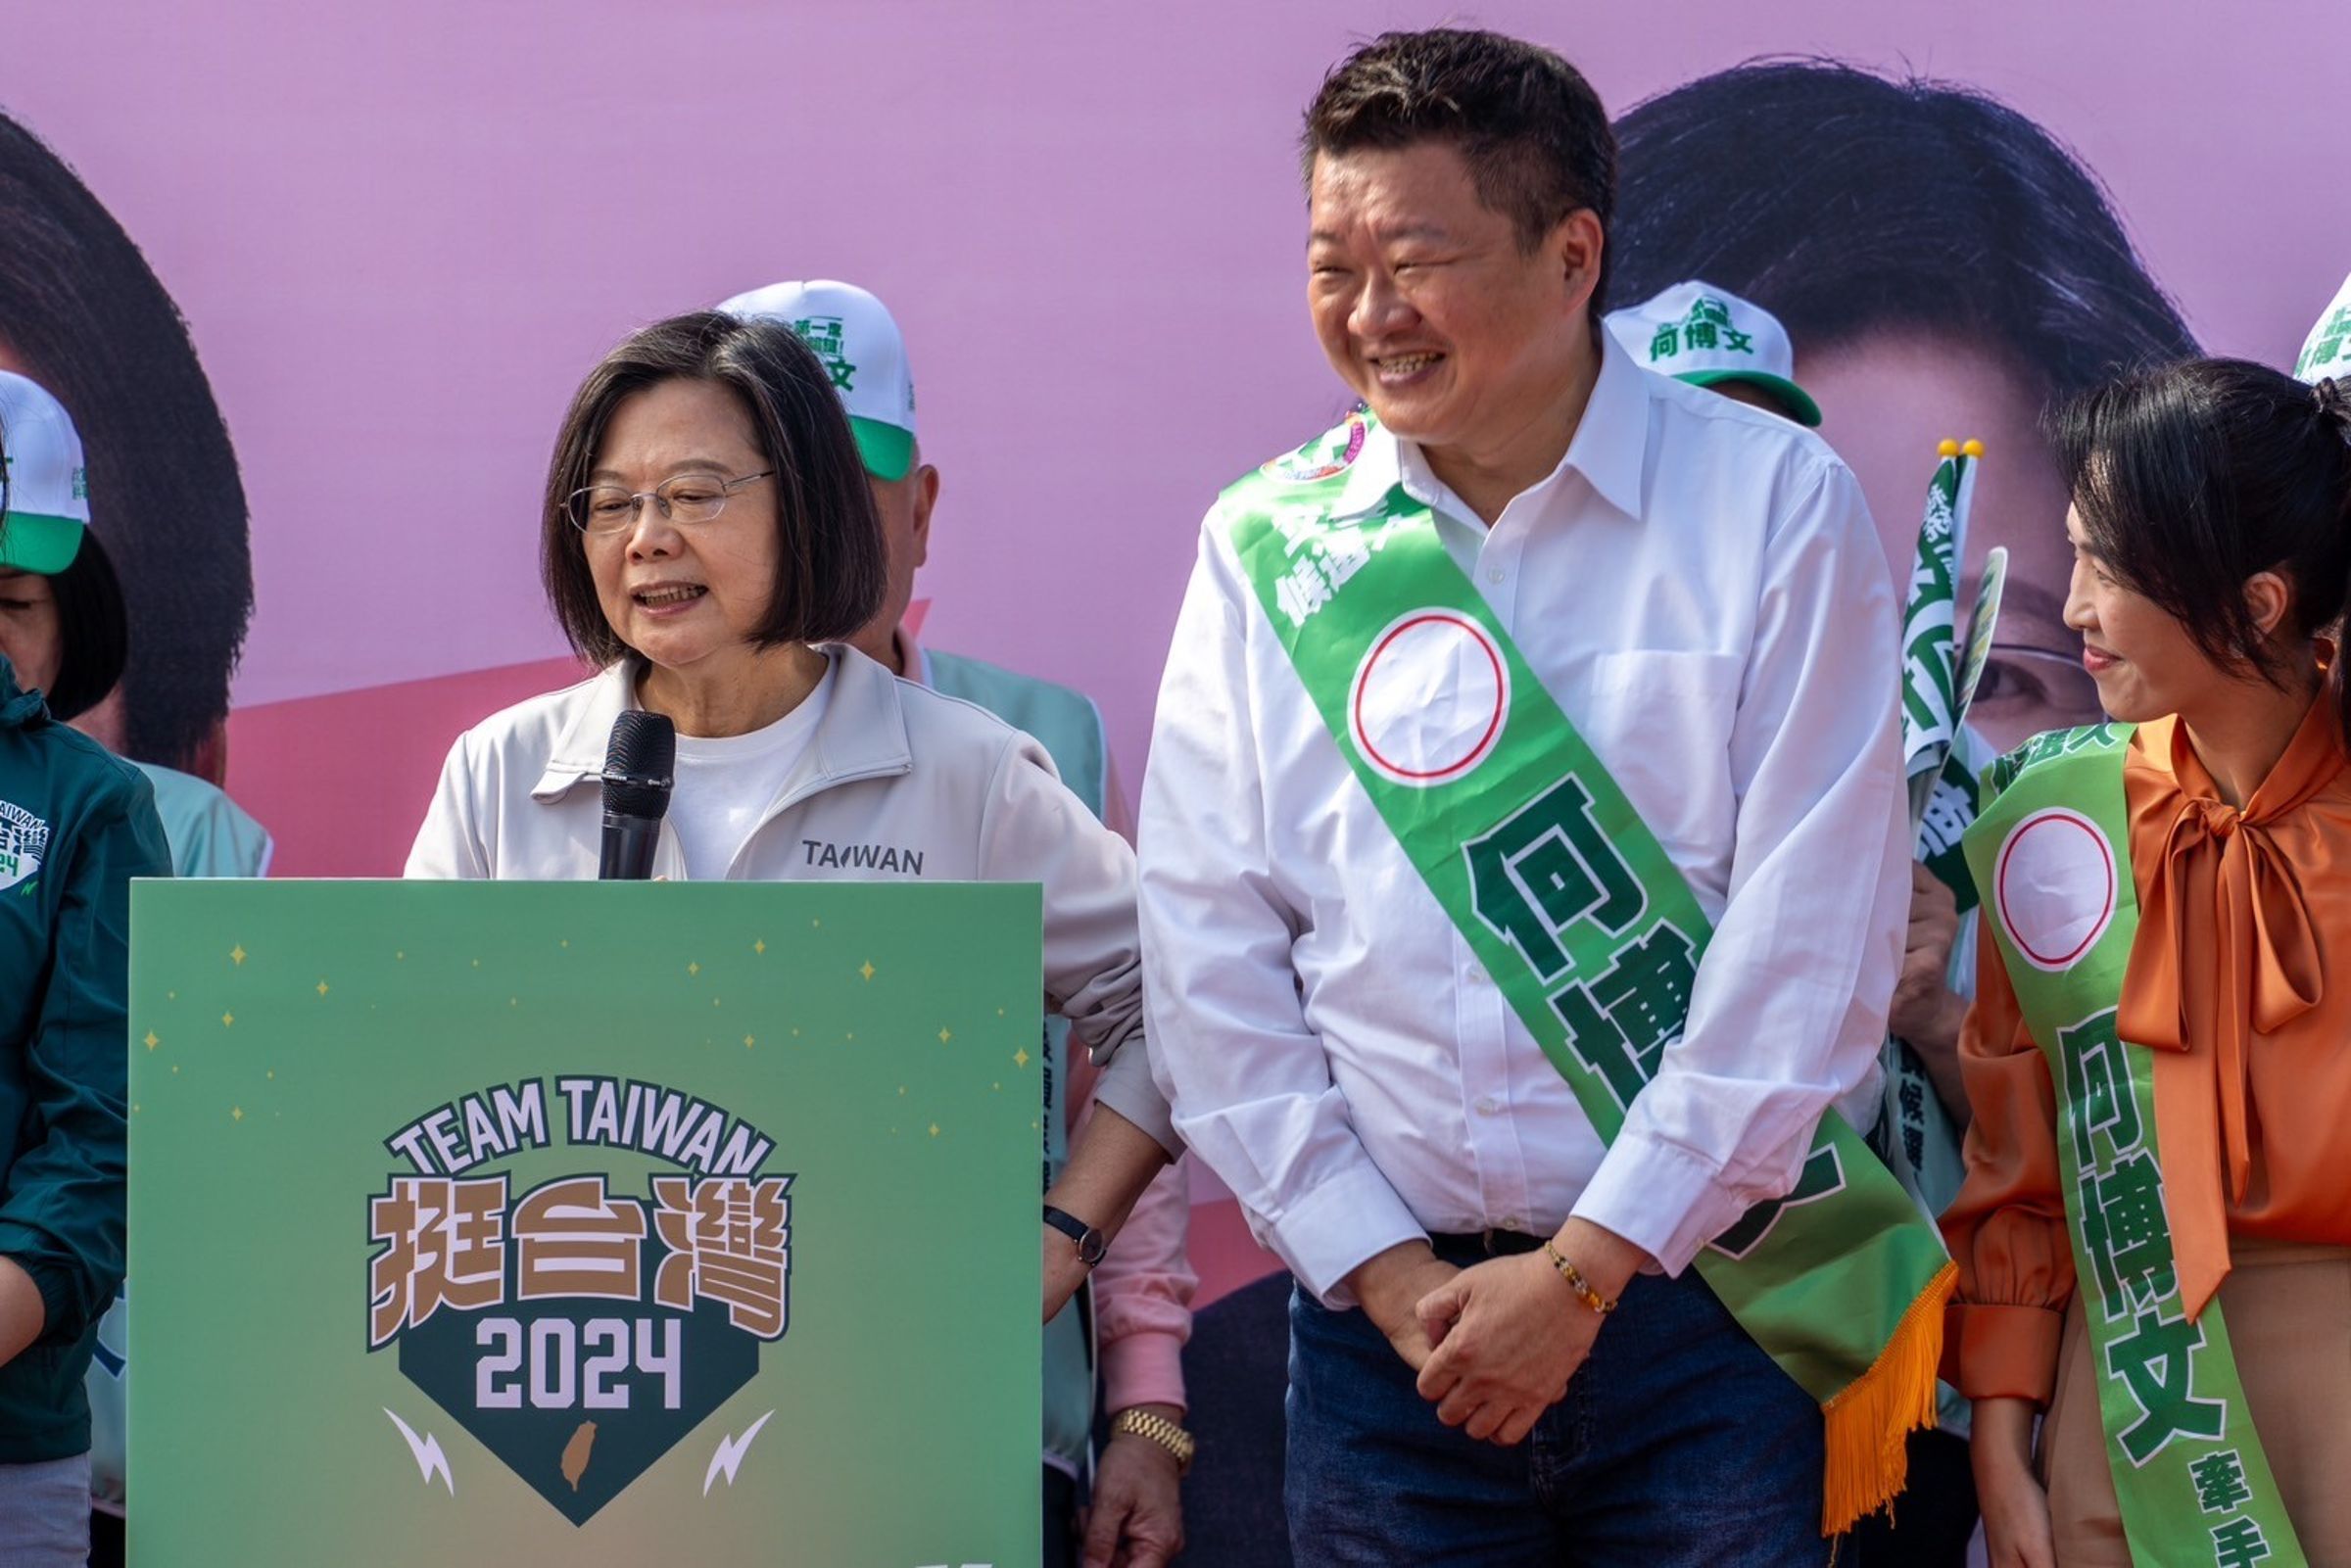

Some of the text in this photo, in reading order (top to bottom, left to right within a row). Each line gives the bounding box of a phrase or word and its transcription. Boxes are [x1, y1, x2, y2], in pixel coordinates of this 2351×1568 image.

[1650, 320, 1754, 362] 何博文
[802, 839, 924, 876] TAIWAN
[386, 1077, 774, 1176] TEAM TAIWAN
[369, 1175, 792, 1348] 挺台灣
[2056, 1005, 2228, 1468] 何博文
[476, 1317, 682, 1409] 2024
